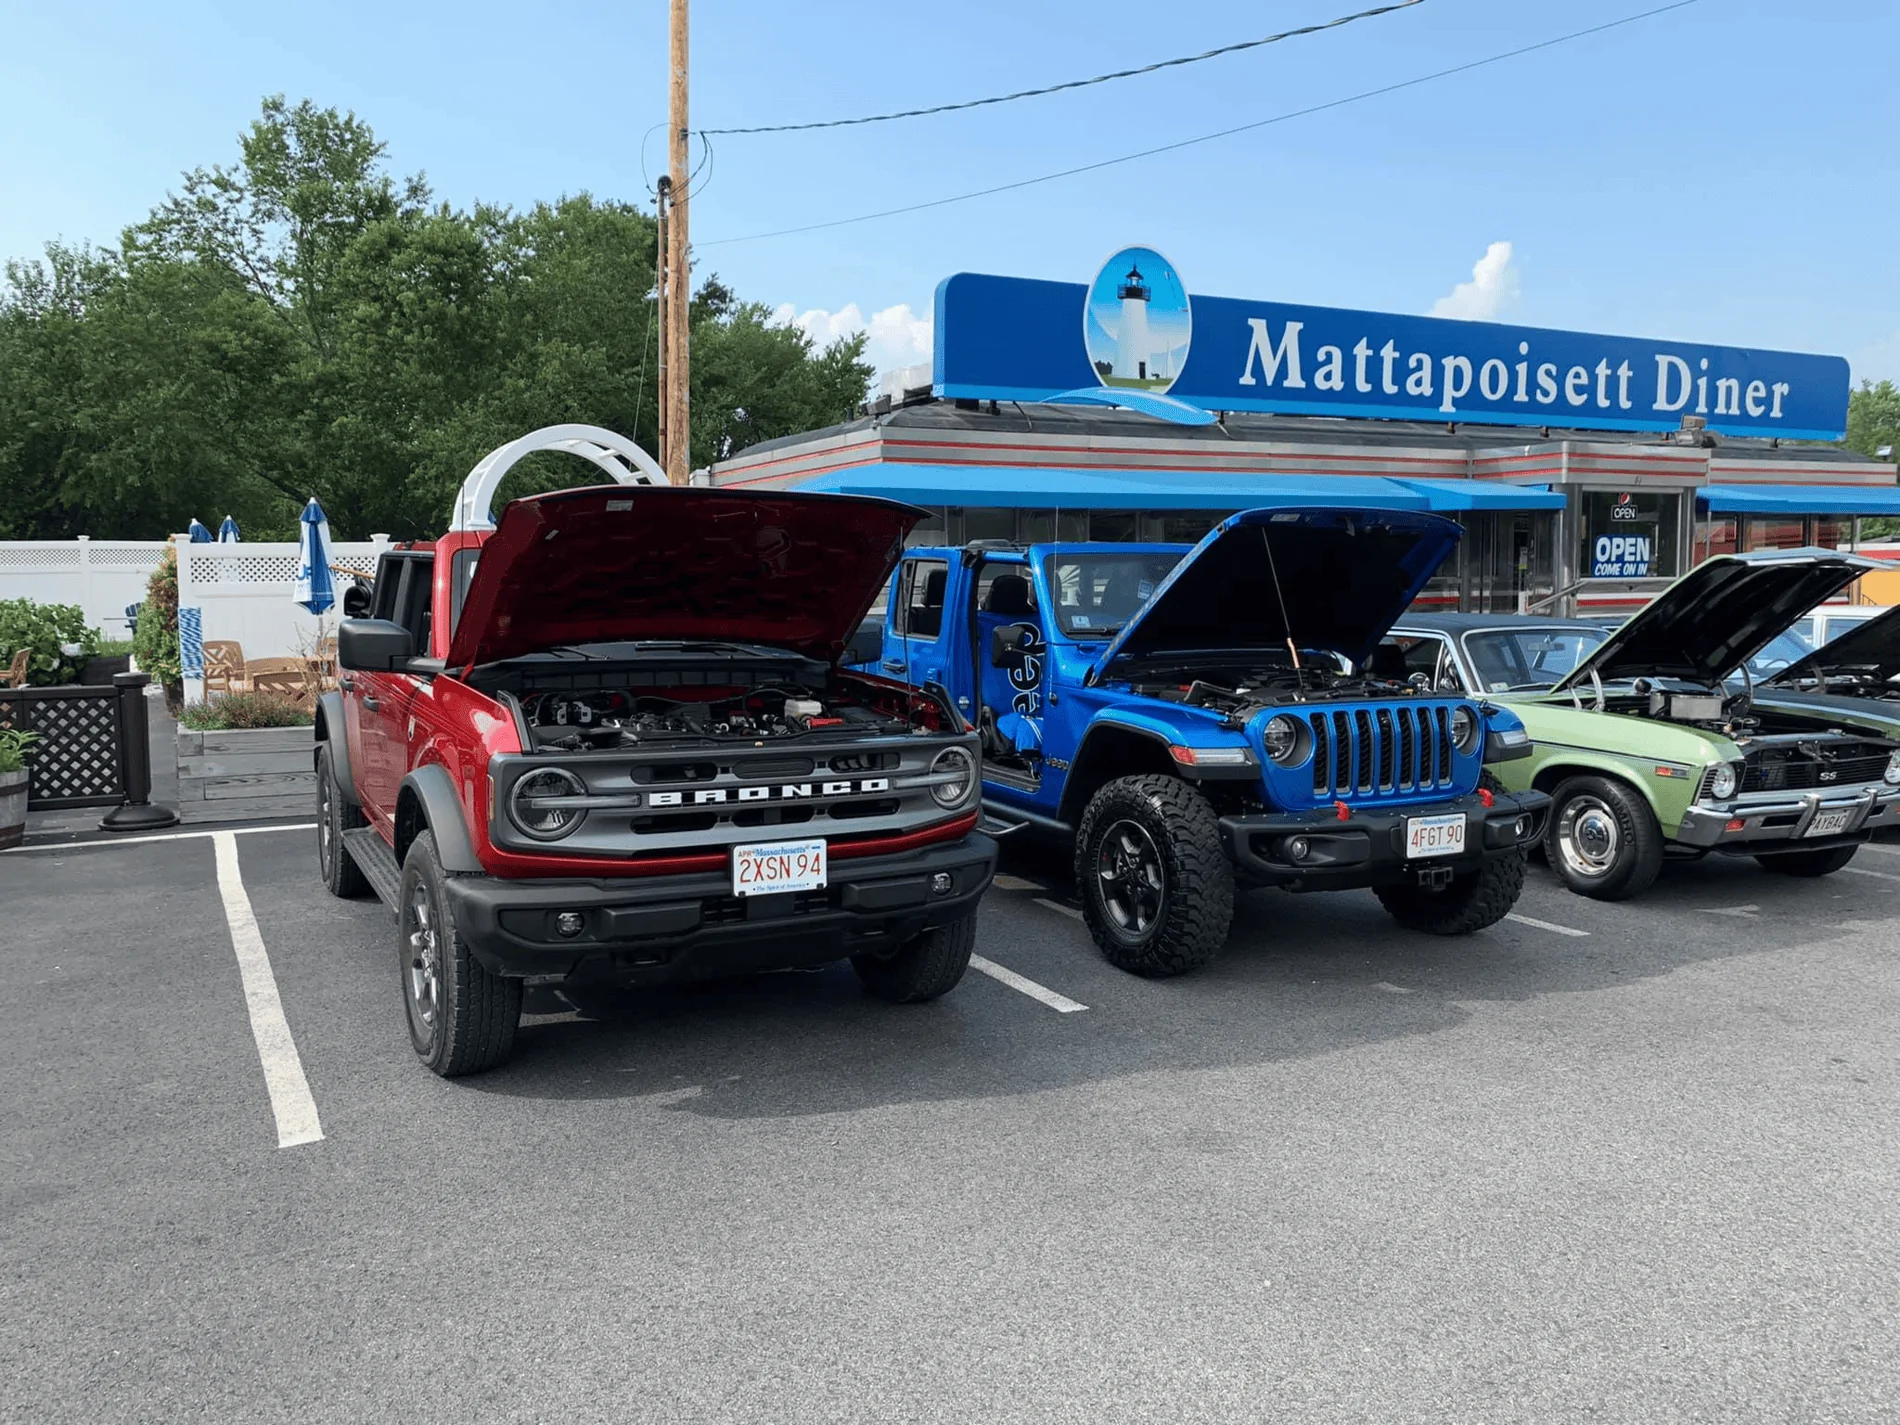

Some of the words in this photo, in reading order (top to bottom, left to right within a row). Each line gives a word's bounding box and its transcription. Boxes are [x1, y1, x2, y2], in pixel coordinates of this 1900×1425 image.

[1238, 317, 1634, 413] Mattapoisett
[1652, 354, 1790, 418] Diner
[1613, 507, 1636, 519] OPEN
[1595, 536, 1650, 562] OPEN
[1594, 563, 1622, 576] COME
[1622, 563, 1637, 576] ON
[1637, 563, 1649, 576] IN
[1819, 771, 1838, 781] SS
[649, 778, 889, 806] BRONCO
[1411, 826, 1444, 847] 4FGT
[1447, 824, 1463, 844] 90
[755, 846, 806, 857] Massachusetts
[740, 855, 791, 883] 2XSN
[797, 853, 821, 877] 94
